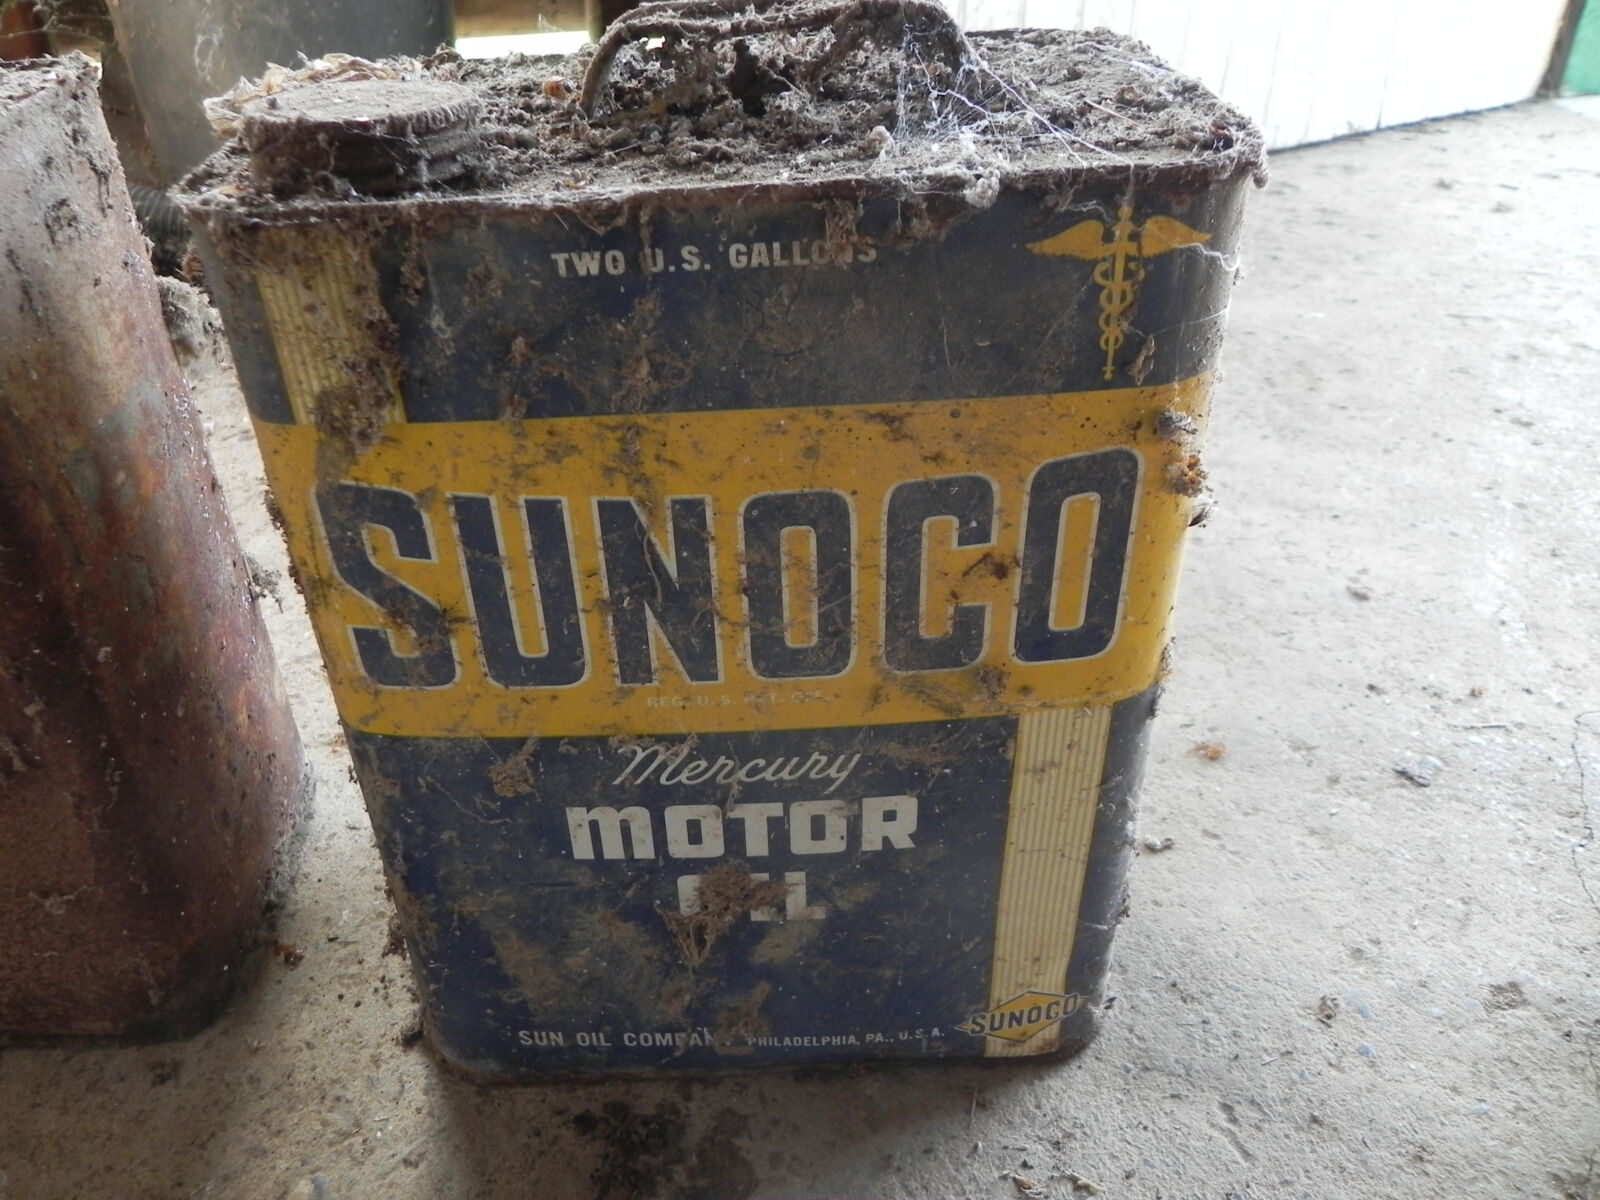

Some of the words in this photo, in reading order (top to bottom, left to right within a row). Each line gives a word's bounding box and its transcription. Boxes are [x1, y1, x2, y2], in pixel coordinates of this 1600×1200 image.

[551, 249, 626, 277] TWO
[648, 245, 711, 273] U.S.
[314, 446, 1144, 689] SUNOCO
[612, 745, 861, 794] Mercury
[565, 794, 919, 860] MOTOR
[518, 1030, 565, 1046] SUN
[576, 1031, 612, 1046] OIL
[748, 1033, 861, 1047] PHILADELPHIA,
[900, 1027, 945, 1042] U.S.A.
[969, 992, 1080, 1036] SUNOCO
